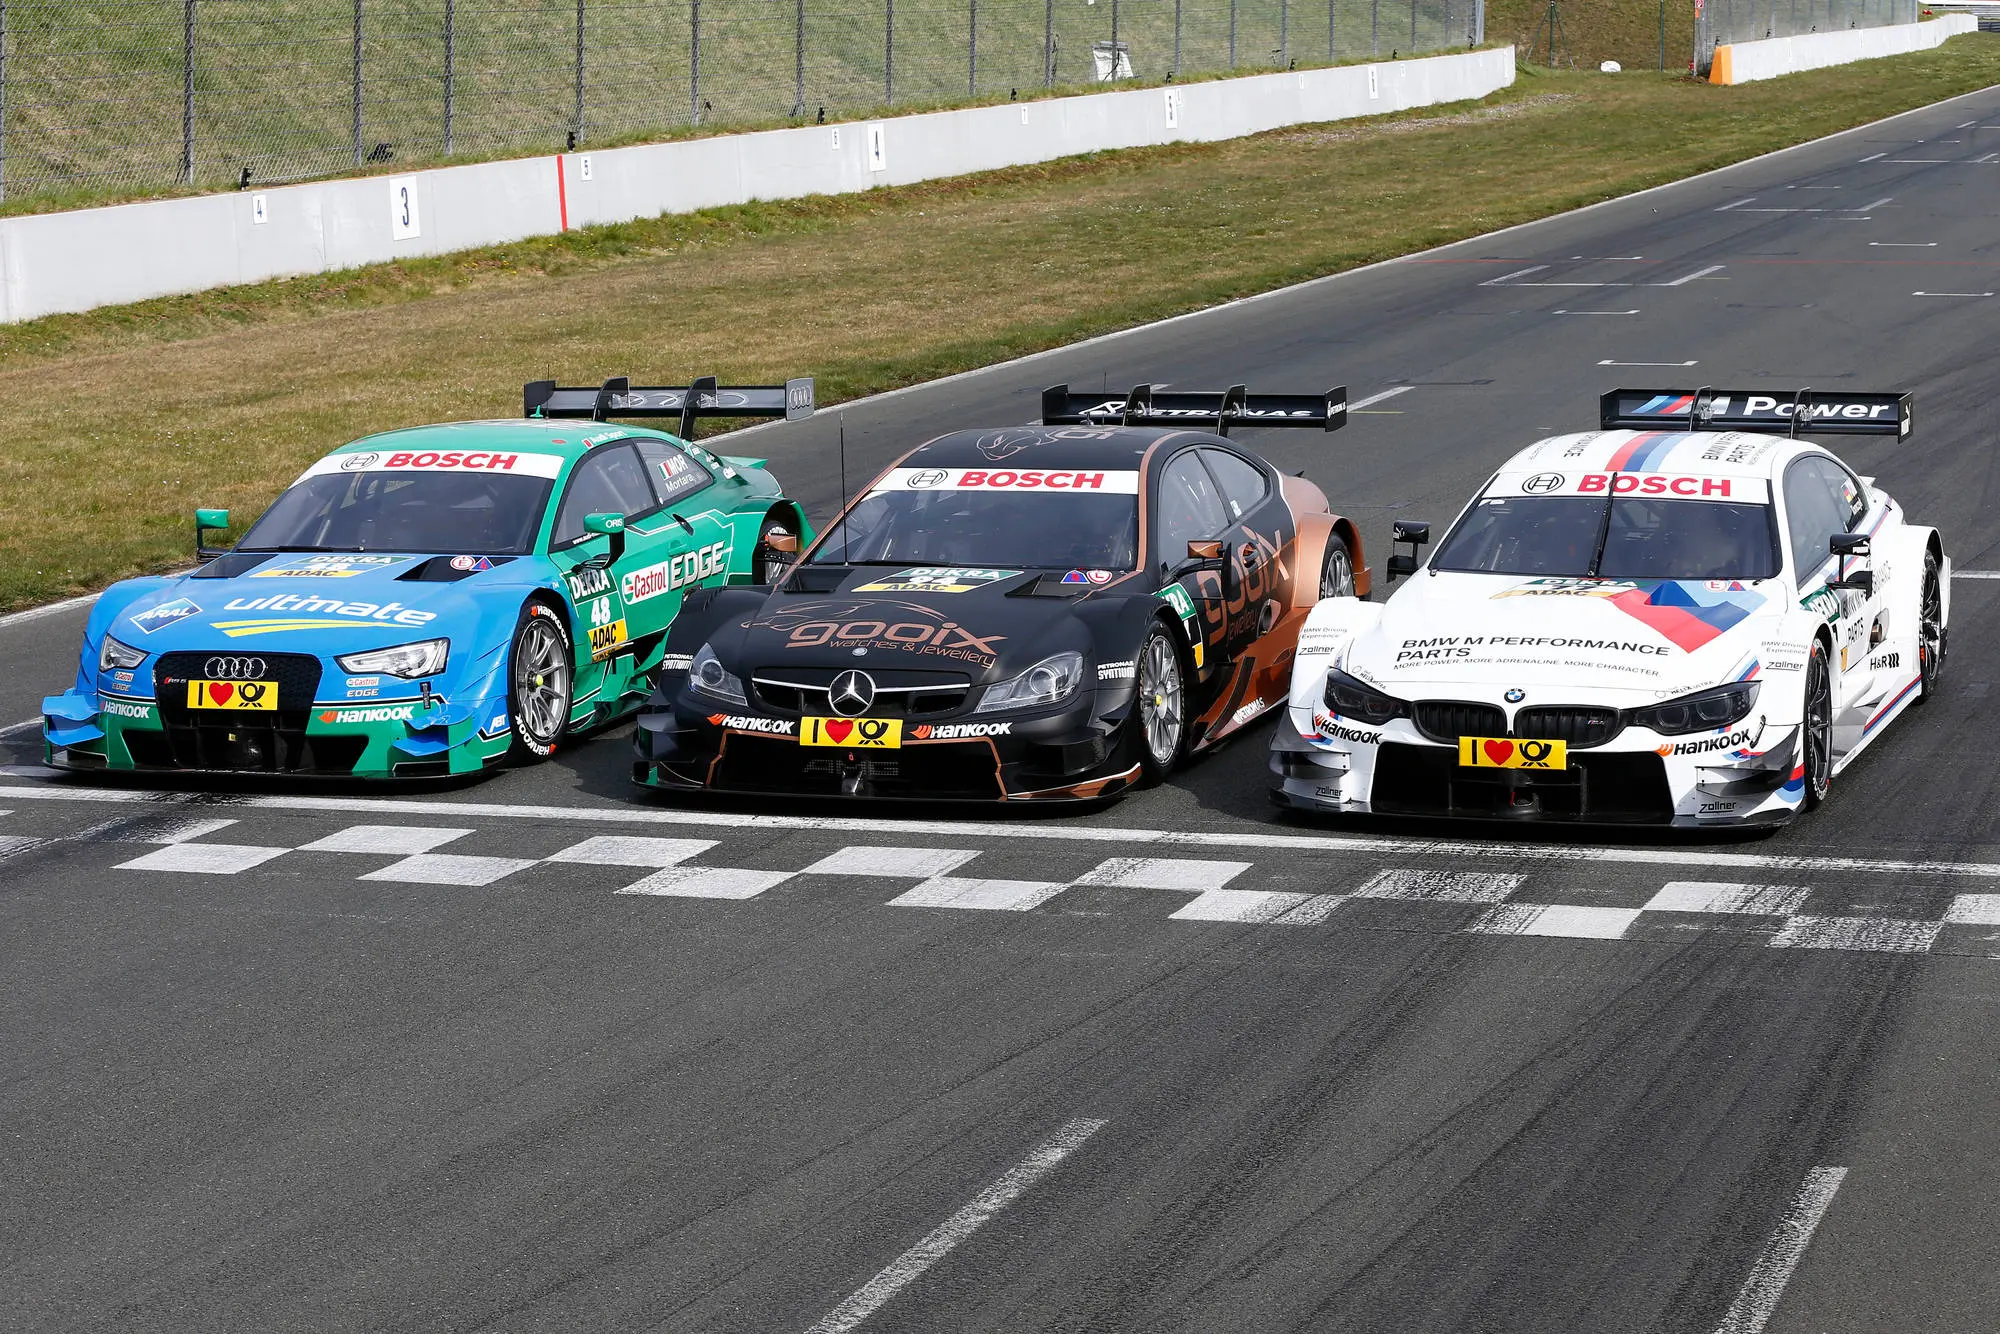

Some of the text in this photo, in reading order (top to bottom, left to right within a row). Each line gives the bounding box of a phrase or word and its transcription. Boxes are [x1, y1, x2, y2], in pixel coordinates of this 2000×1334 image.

[873, 130, 880, 161] 4
[584, 159, 590, 176] 5
[256, 199, 263, 218] 4
[400, 186, 410, 226] 3
[1743, 396, 1889, 418] Power
[384, 452, 518, 470] BOSCH
[668, 453, 689, 477] MOR
[665, 474, 695, 494] Mortara
[956, 471, 1104, 489] BOSCH
[1577, 474, 1731, 497] BOSCH
[605, 518, 623, 528] ORIS
[310, 555, 392, 564] DEKRA
[669, 541, 726, 590] EDGE
[633, 567, 667, 598] Castrol
[910, 567, 999, 579] DEKRA
[570, 567, 611, 599] DEKRA
[884, 583, 948, 591] ADAC
[1541, 578, 1639, 588] DEKRA
[135, 606, 193, 622] ARAL
[223, 594, 437, 626] ultimate
[591, 597, 611, 627] 48
[592, 624, 617, 651] ADAC
[785, 621, 1008, 655] gooix
[1401, 637, 1671, 656] BMW M PERFORMANCE
[830, 638, 997, 669] watches & jewellery
[1397, 647, 1472, 662] PARTS
[1870, 655, 1887, 671] H&R
[662, 659, 692, 671] SYNTIUM
[1097, 660, 1134, 670] PETRONAS
[1097, 666, 1135, 681] SYNTIUM
[1393, 661, 1422, 670] MORE
[1464, 657, 1493, 665] MORE
[1564, 660, 1594, 668] MORE
[1597, 662, 1661, 679] CHARACTER.
[112, 683, 130, 692] EDGE
[353, 678, 378, 687] Castrol
[198, 682, 204, 706] I
[346, 688, 379, 698] EDGE
[489, 714, 508, 733] ABT
[812, 719, 819, 743] I
[1471, 739, 1478, 765] I
